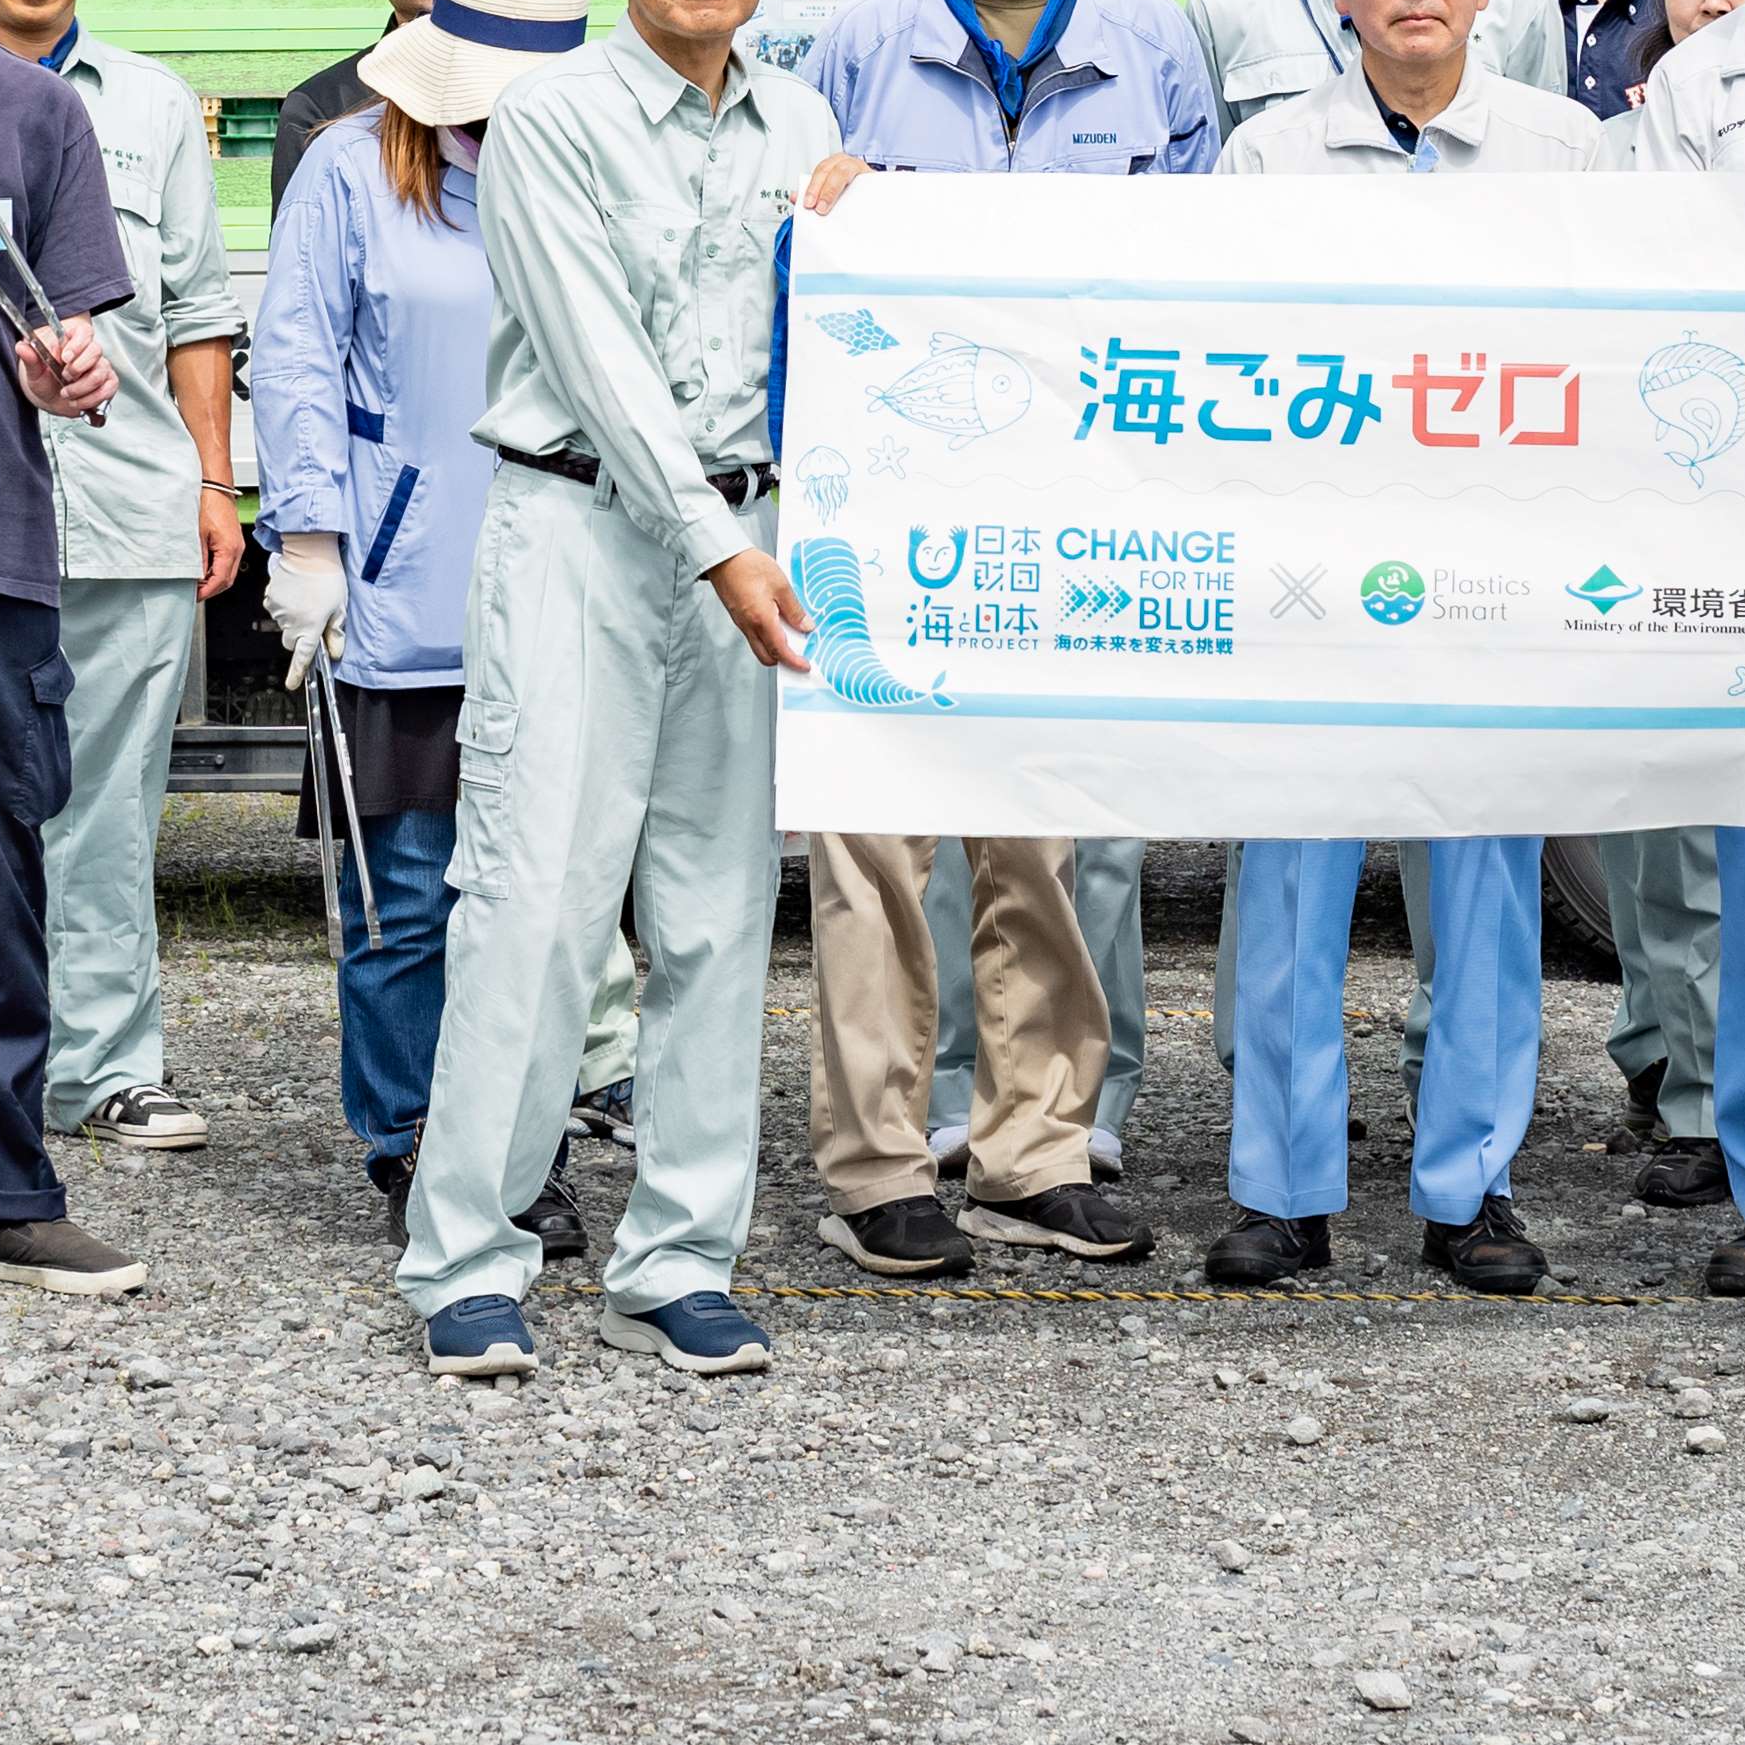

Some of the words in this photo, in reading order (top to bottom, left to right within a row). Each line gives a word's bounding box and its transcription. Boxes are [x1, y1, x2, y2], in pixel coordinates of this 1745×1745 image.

[1072, 132, 1117, 144] MIZUDEN
[1074, 337, 1580, 448] 海ごみゼロ
[975, 525, 1041, 556] 日本
[1056, 527, 1235, 563] CHANGE
[974, 562, 1040, 592] 財団
[1139, 570, 1187, 591] FOR
[1193, 571, 1235, 592] THE
[1433, 569, 1531, 596] Plastics
[906, 594, 1040, 649] 海と日本
[1138, 596, 1235, 632] BLUE
[1432, 594, 1508, 622] Smart
[1564, 619, 1625, 635] Ministry
[1628, 621, 1644, 633] of
[1647, 621, 1669, 633] the
[958, 637, 1040, 651] PROJECT
[1054, 633, 1234, 655] 海の未来を変える挑戦
